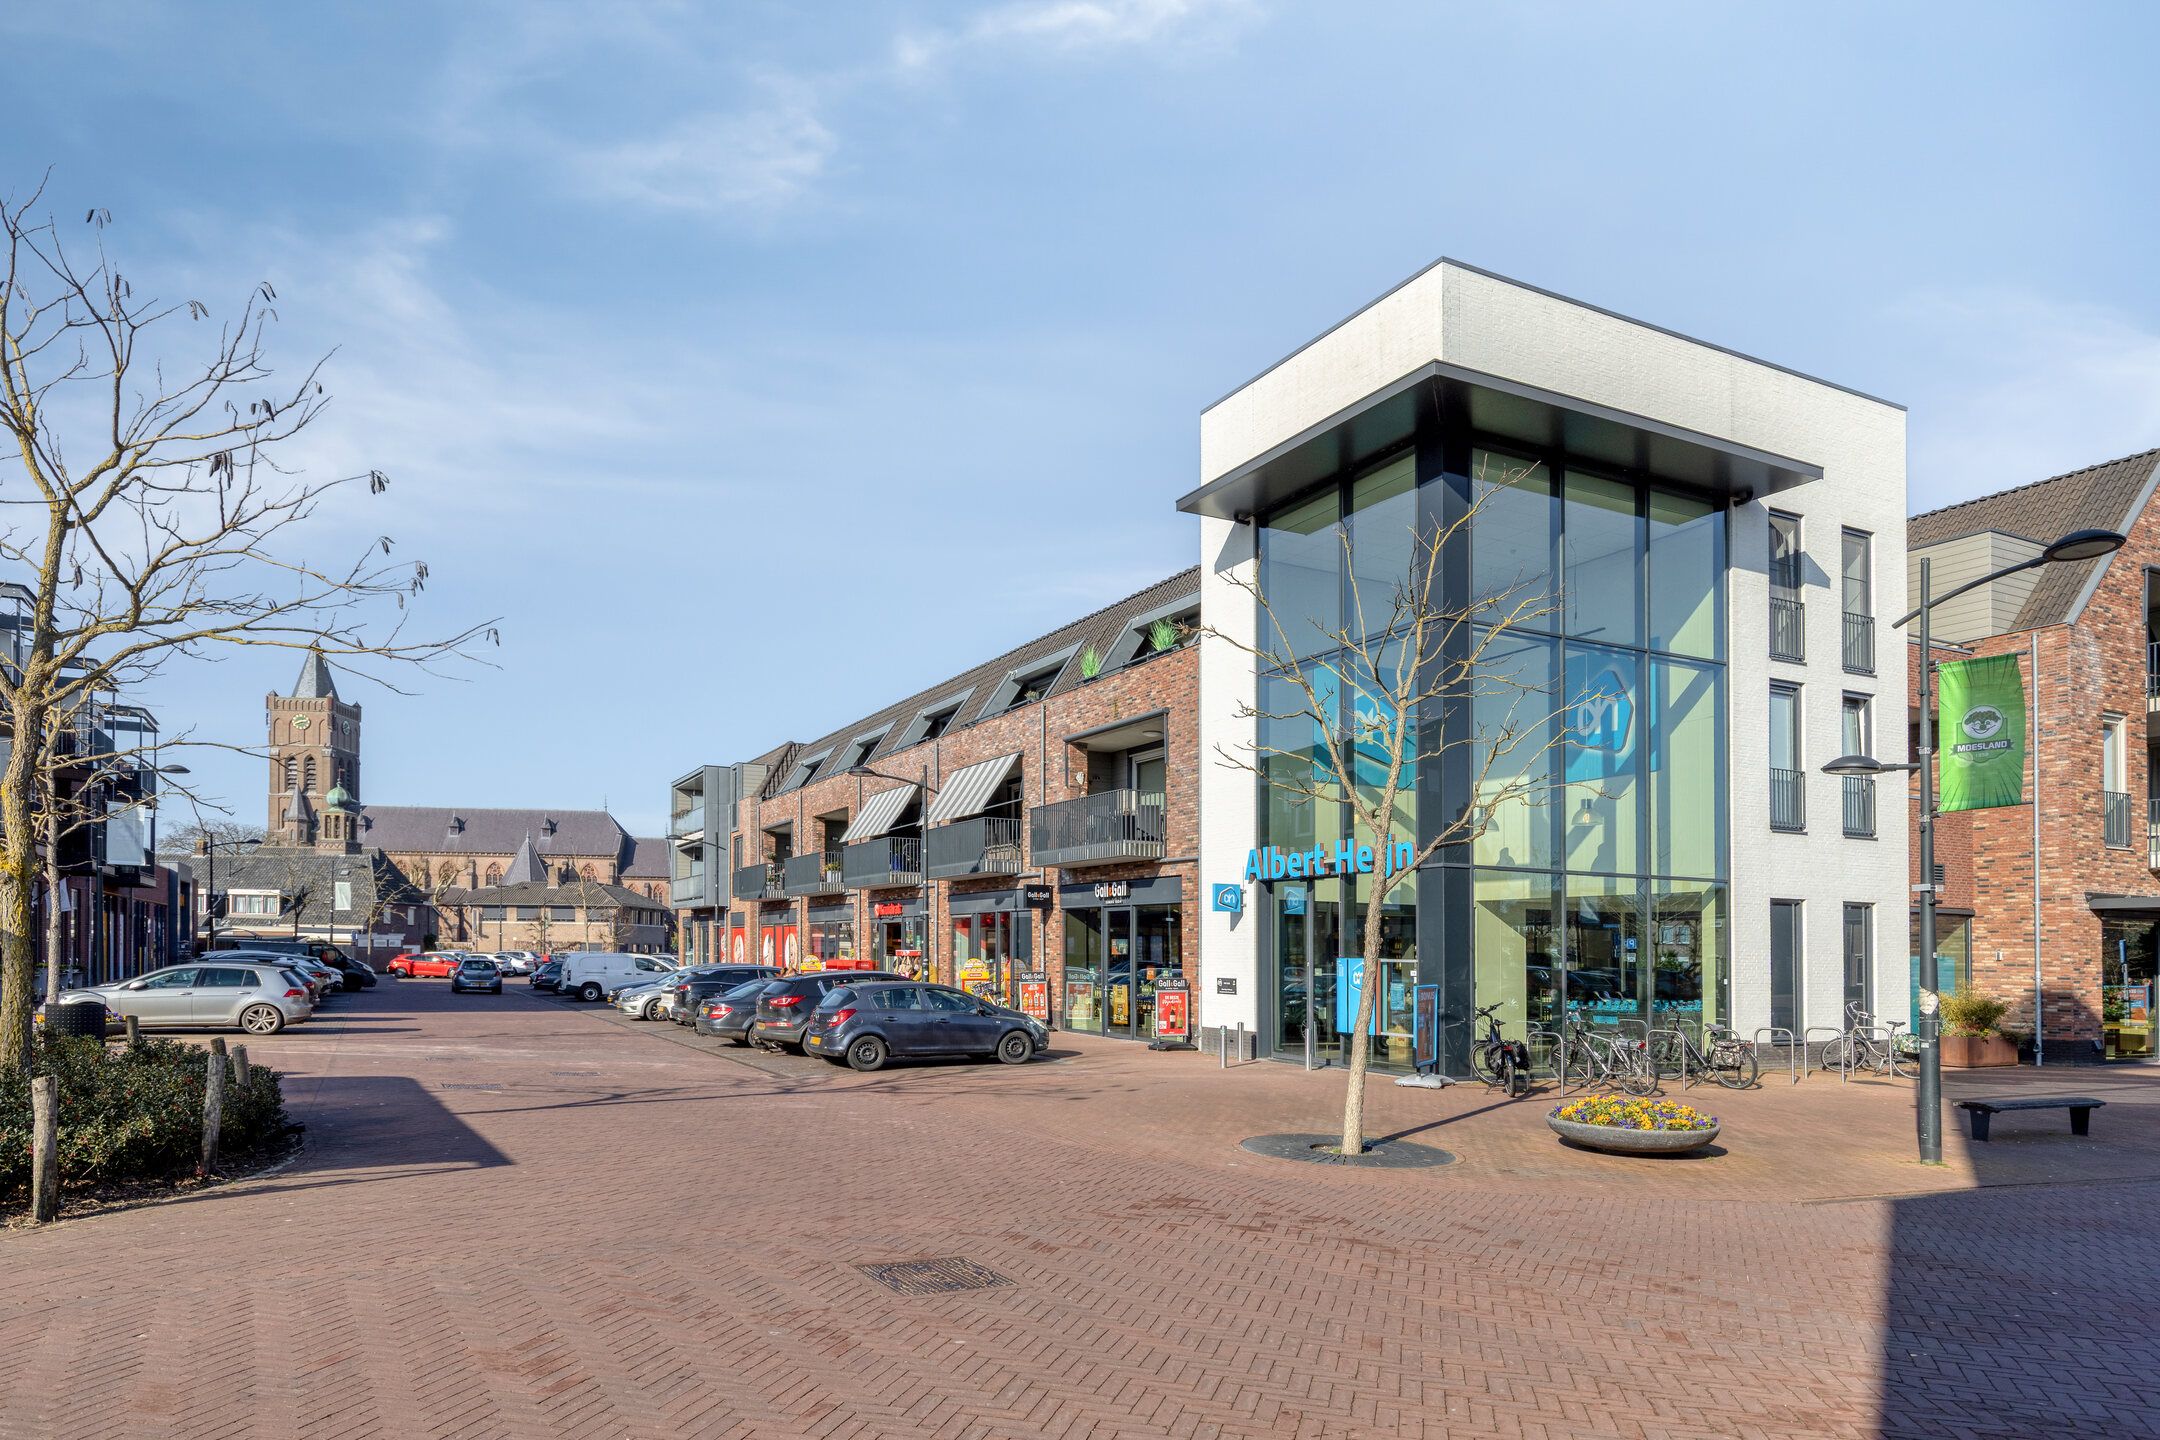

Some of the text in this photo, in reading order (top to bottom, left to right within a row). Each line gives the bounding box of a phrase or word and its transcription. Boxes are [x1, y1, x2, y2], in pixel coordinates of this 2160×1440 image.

[1957, 740, 2008, 752] MOESLAND
[1245, 834, 1415, 880] Albert Hejn
